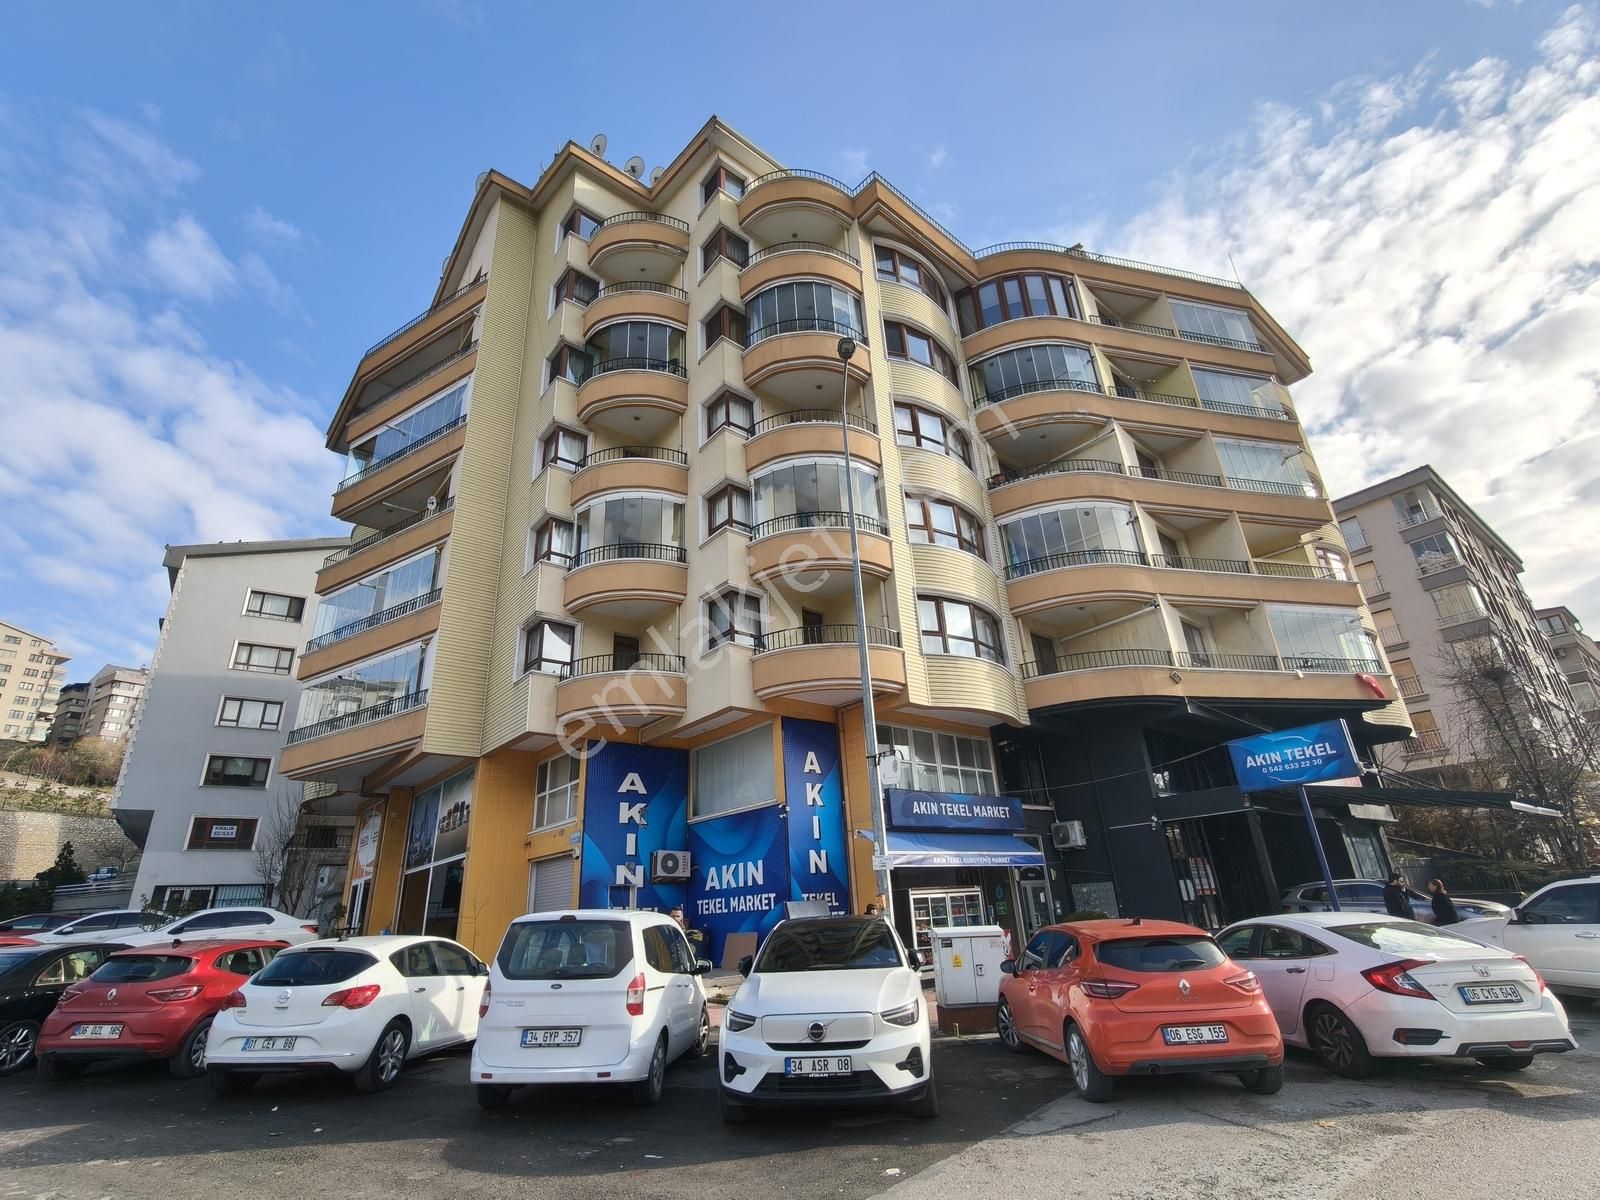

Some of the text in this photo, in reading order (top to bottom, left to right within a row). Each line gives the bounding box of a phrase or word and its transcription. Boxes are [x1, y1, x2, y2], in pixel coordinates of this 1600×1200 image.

[1246, 742, 1337, 769] AKIN TEKEL
[1268, 765, 1283, 773] 542
[1311, 758, 1322, 766] 30
[913, 801, 1010, 819] AKIN TEKEL MARKET
[705, 860, 764, 891] AKIN
[697, 893, 776, 915] TEKEL MARKET
[1467, 989, 1480, 1000] 06
[1481, 988, 1498, 999] CYG
[528, 1031, 578, 1043] 34 GYP 357
[1169, 1026, 1226, 1041] 06 ESG 155
[248, 1040, 257, 1049] 01
[283, 1039, 293, 1049] 86
[791, 1058, 849, 1072] 34 ASR 08
